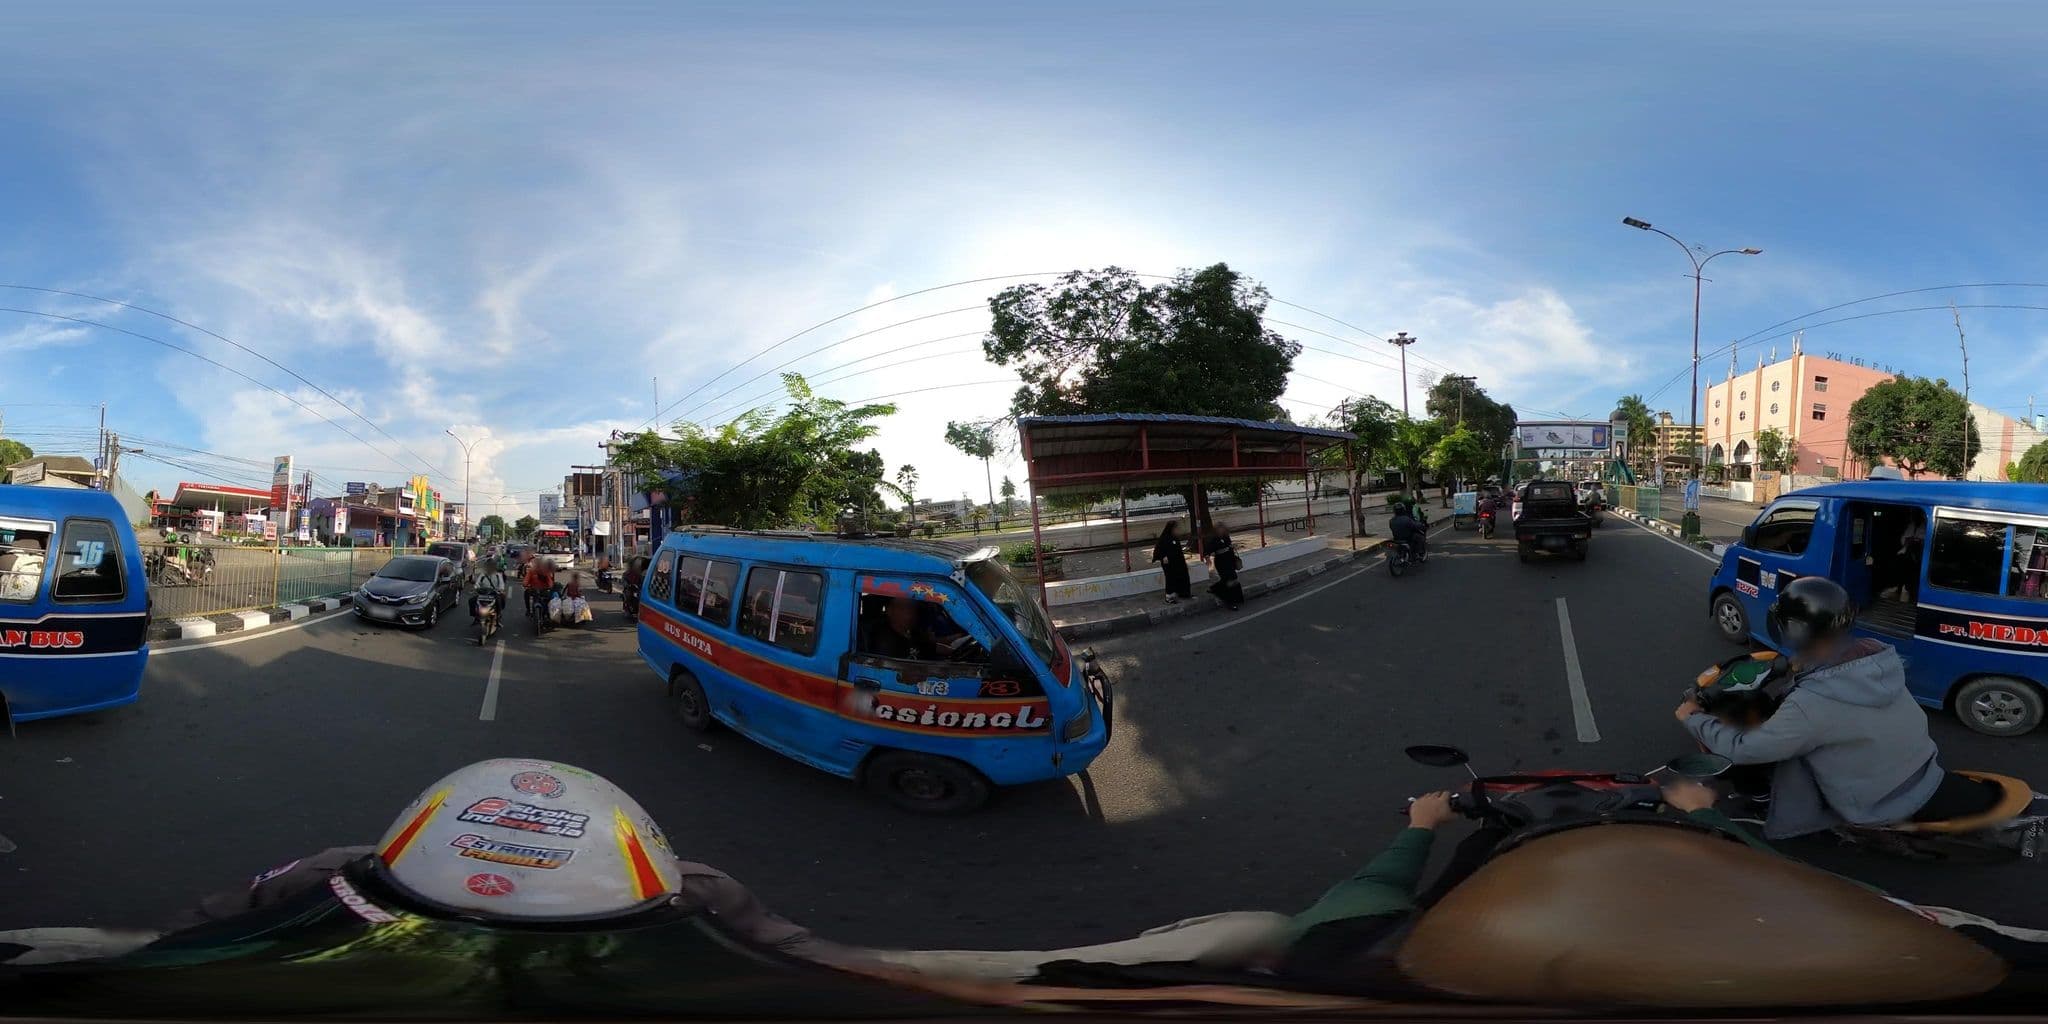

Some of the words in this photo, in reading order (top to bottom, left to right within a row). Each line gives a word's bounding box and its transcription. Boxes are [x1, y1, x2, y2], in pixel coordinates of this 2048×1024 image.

[72, 540, 104, 566] 36
[30, 630, 84, 649] BUS
[663, 621, 681, 638] BUS
[682, 631, 713, 656] KOTA
[1939, 623, 1968, 637] PT.
[466, 798, 512, 816] 2
